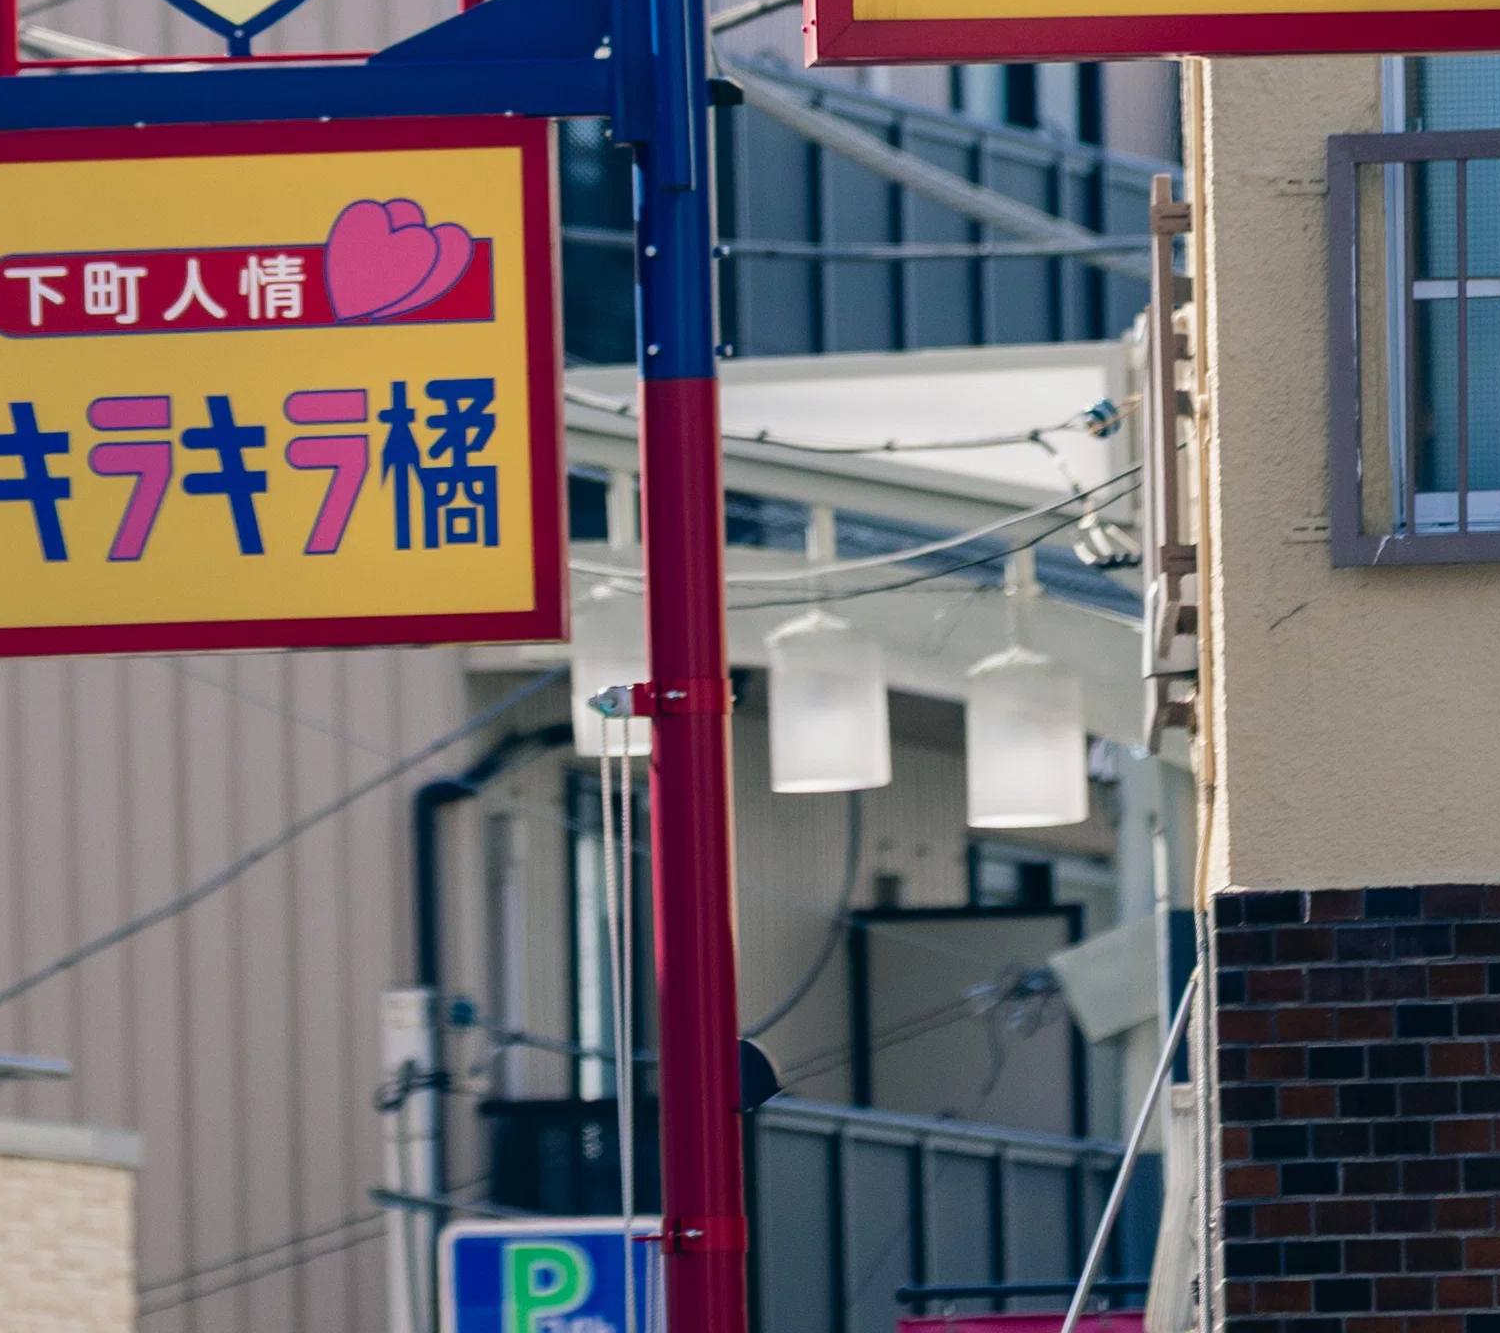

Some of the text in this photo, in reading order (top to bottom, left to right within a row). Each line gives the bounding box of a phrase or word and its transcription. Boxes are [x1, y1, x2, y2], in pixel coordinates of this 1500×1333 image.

[1, 253, 309, 327] 下町人情
[502, 1241, 597, 1333] P
